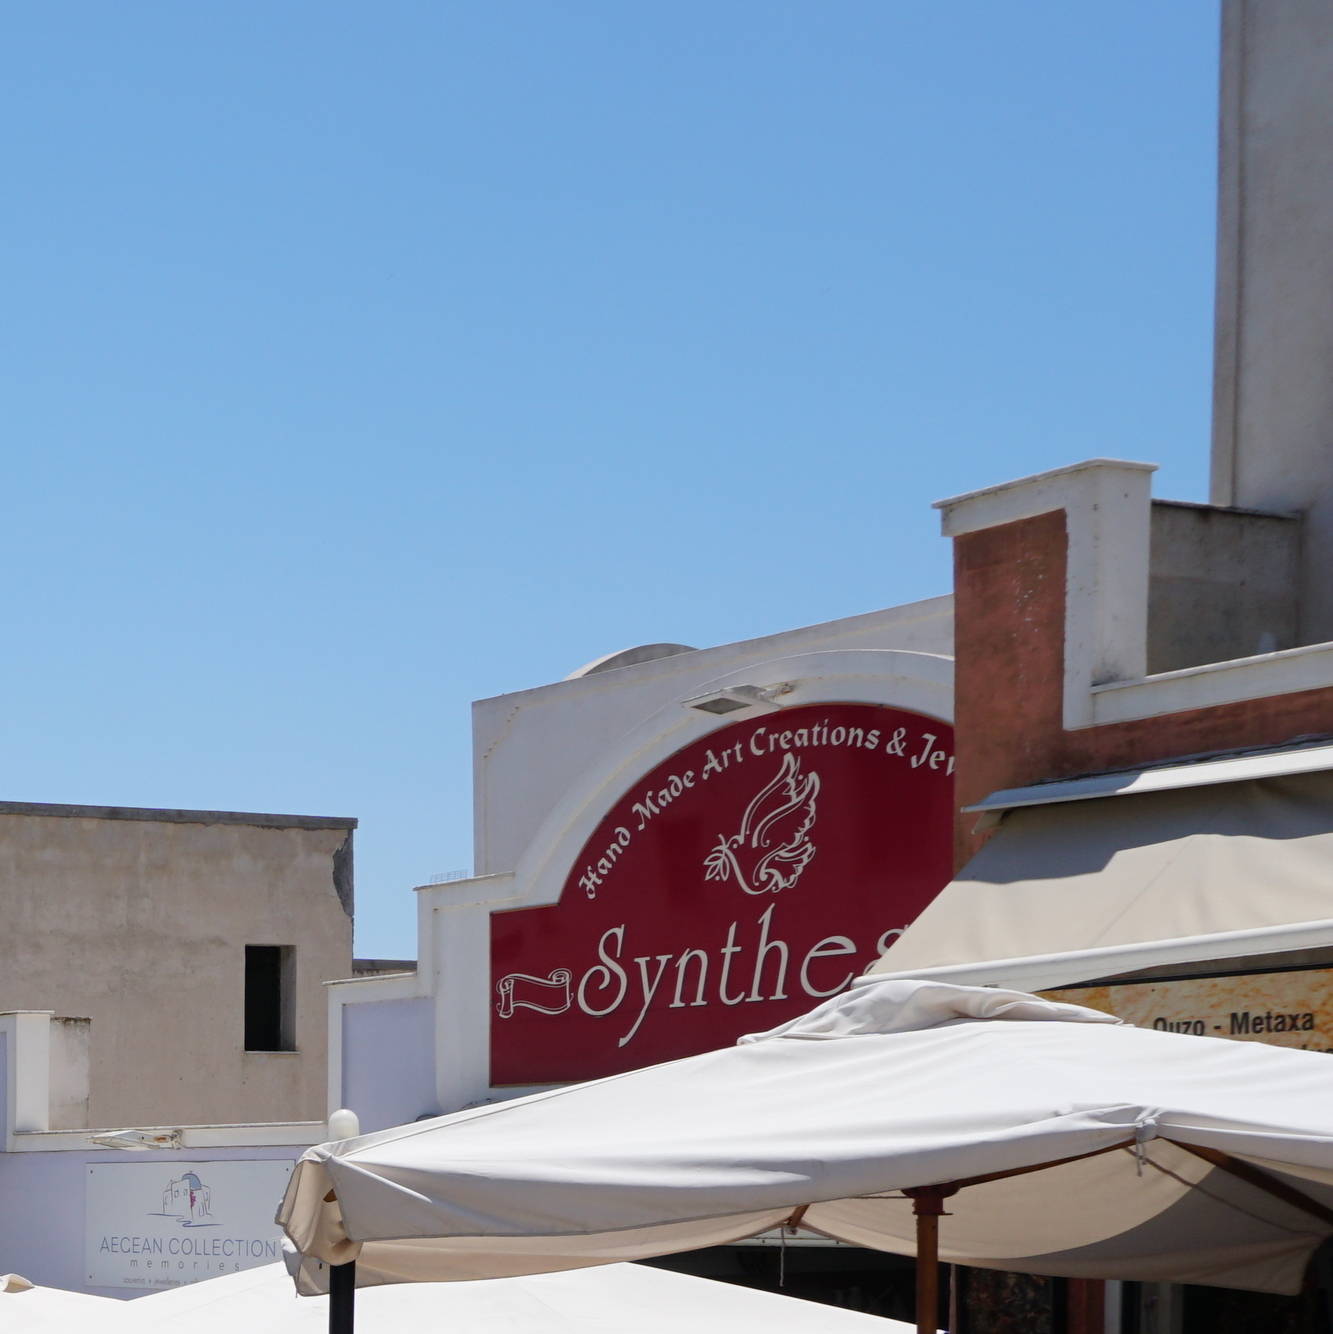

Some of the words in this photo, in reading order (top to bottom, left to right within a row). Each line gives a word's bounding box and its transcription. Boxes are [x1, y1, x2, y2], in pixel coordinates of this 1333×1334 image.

[579, 825, 631, 899] Hand
[632, 770, 695, 831] Made
[701, 743, 743, 780] Art
[750, 718, 881, 756] Creations
[886, 727, 907, 756] &
[1230, 1011, 1315, 1035] Metaxa
[99, 1237, 162, 1254] AEGEAN
[168, 1237, 276, 1257] COLLECTION
[130, 1258, 240, 1271] memories
